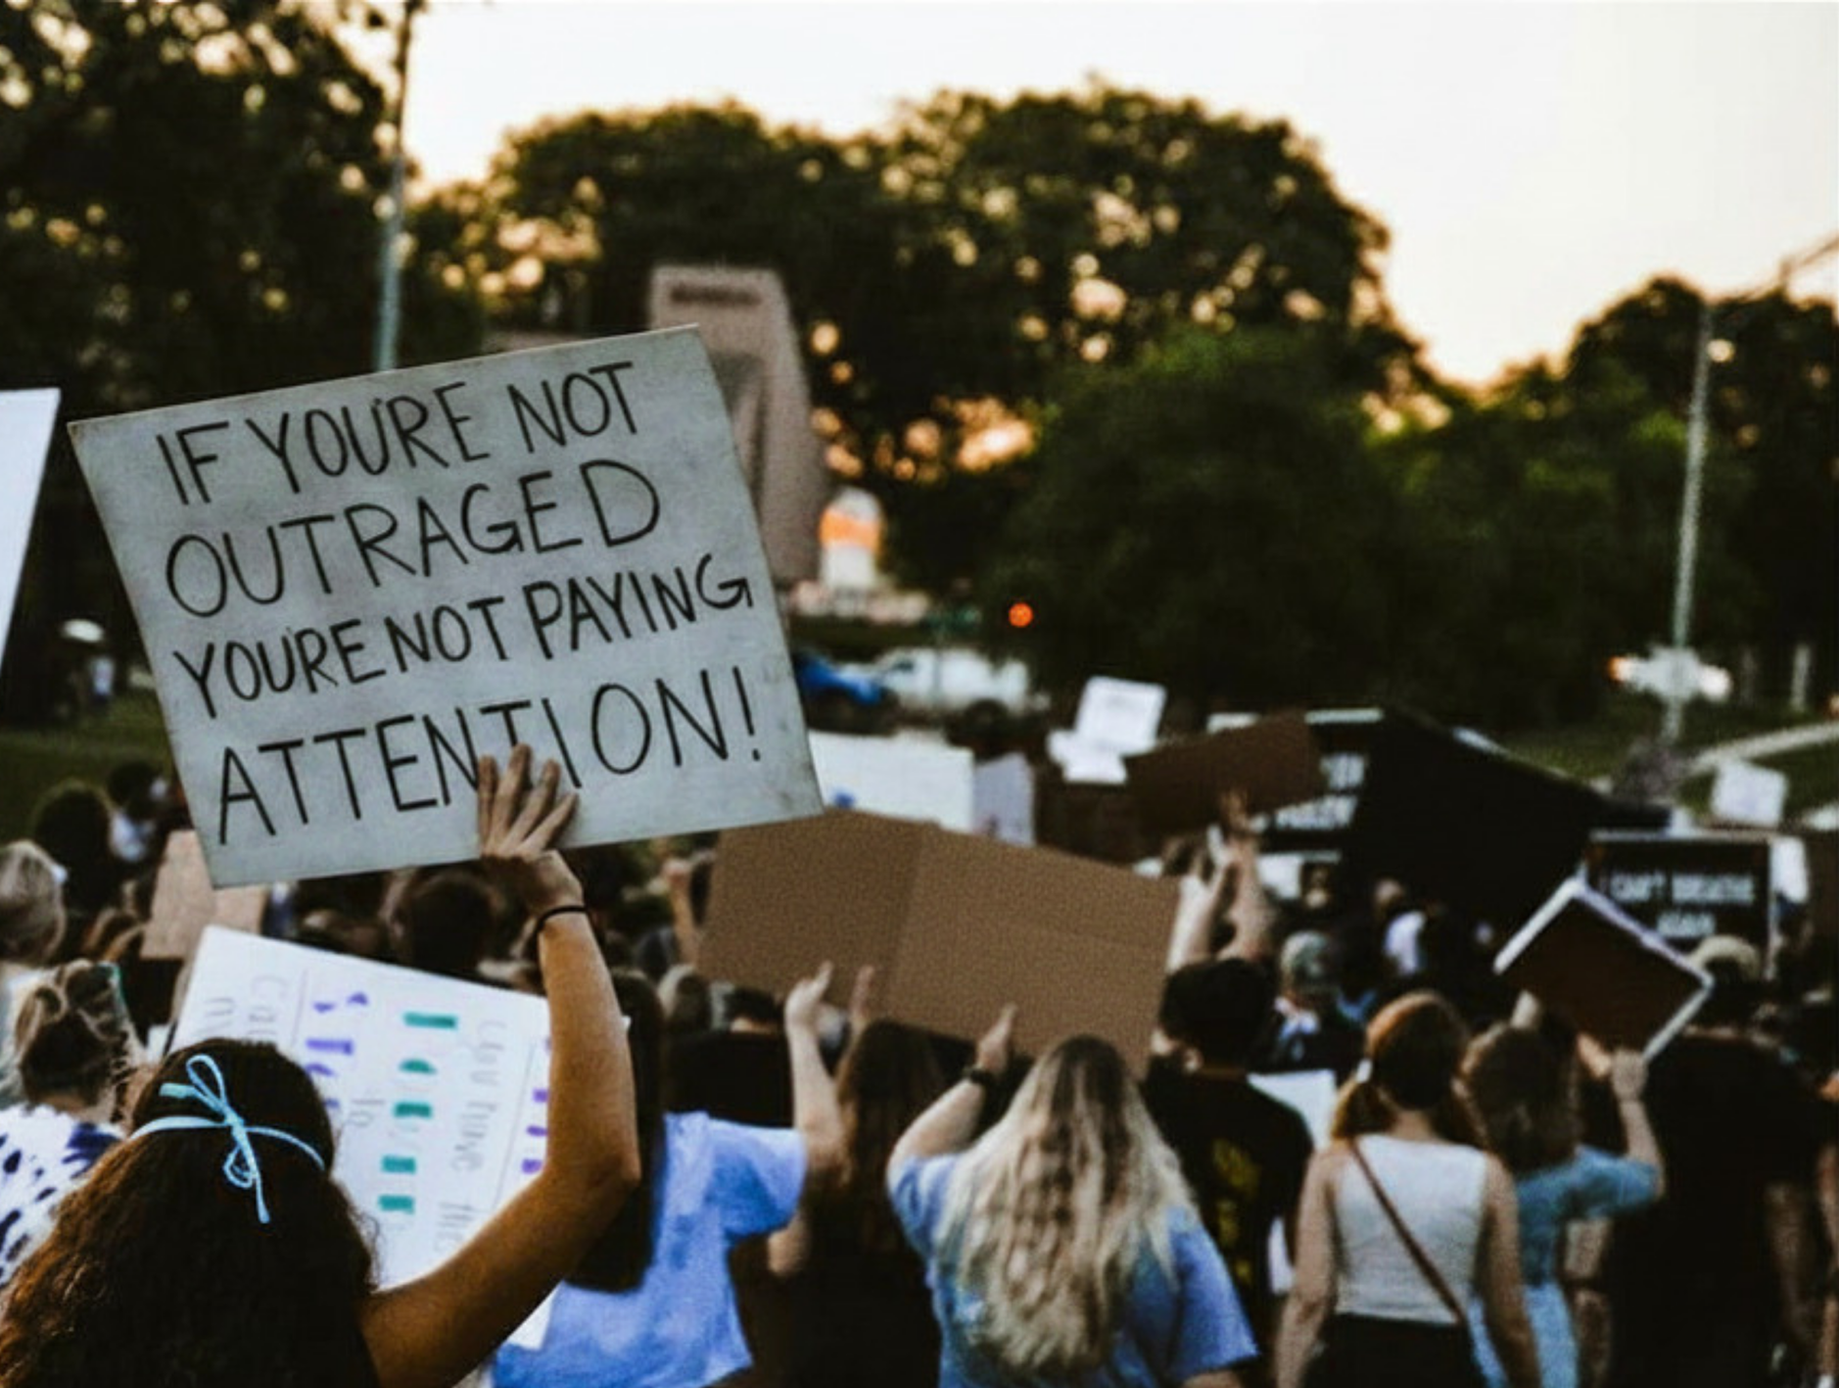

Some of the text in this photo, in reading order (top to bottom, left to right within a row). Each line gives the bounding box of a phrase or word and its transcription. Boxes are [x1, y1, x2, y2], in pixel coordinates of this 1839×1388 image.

[156, 422, 229, 505] IF
[507, 362, 637, 453] NOT
[167, 460, 660, 618] OUTRAGED
[386, 596, 509, 673] NOT
[522, 553, 753, 660] PAYING
[219, 666, 760, 845] ATTENTION!
